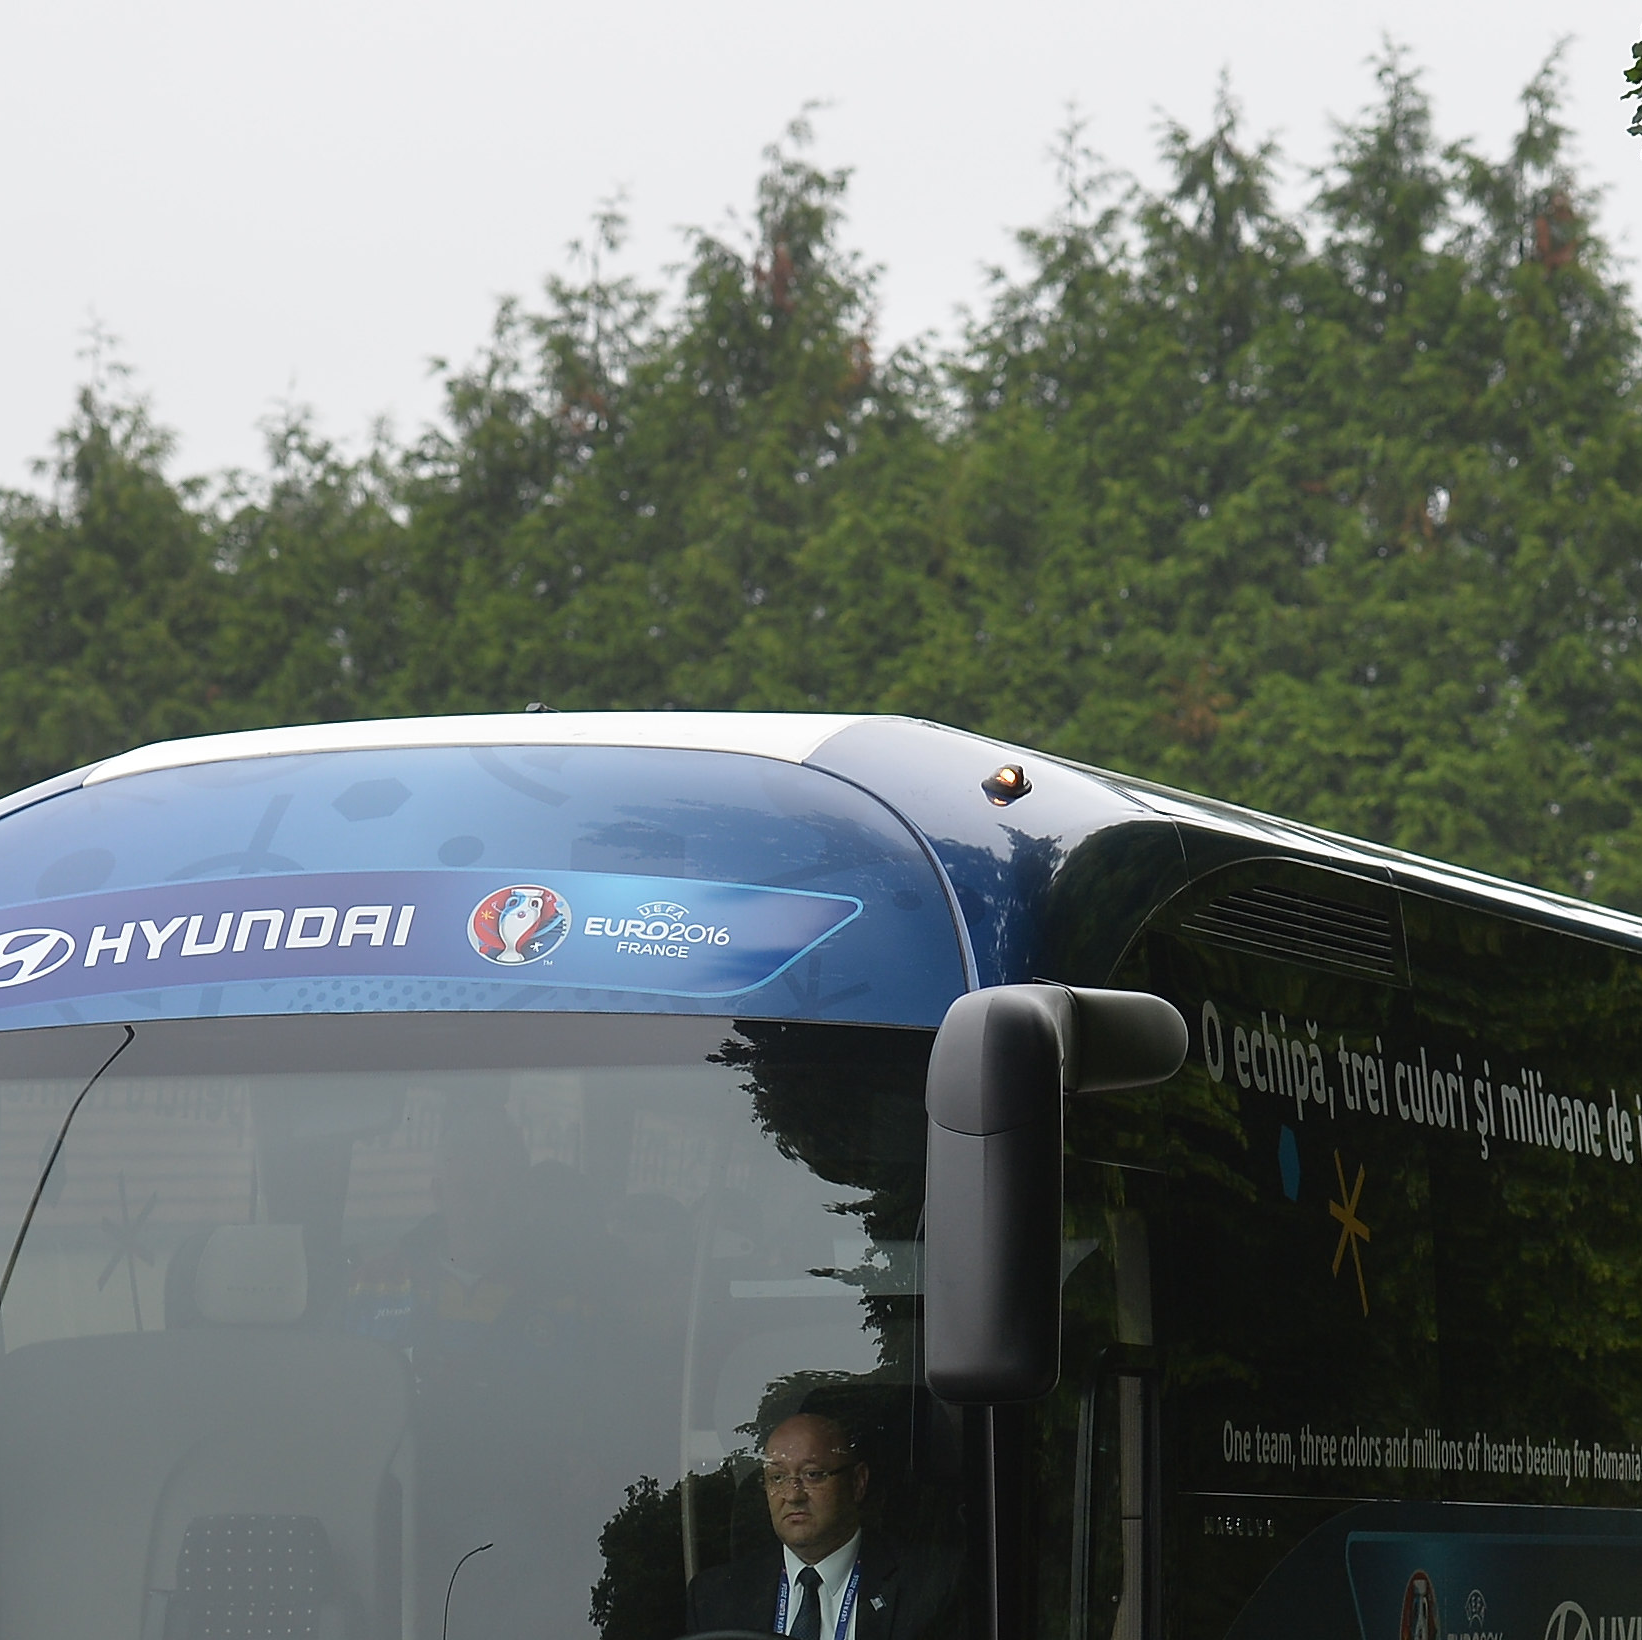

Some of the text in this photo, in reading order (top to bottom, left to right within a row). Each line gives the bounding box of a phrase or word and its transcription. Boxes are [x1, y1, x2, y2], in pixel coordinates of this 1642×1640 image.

[583, 917, 731, 946] EURO2016
[638, 904, 685, 921] UEFA
[83, 904, 416, 968] HYUNDAI
[616, 941, 690, 959] FRANCE
[1202, 1000, 1225, 1083] O
[1233, 1011, 1335, 1121] echipă,
[1338, 1034, 1389, 1116] trei
[1394, 1046, 1469, 1132] culori
[1500, 1067, 1603, 1158] milioane
[1607, 1089, 1634, 1165] de
[1222, 1420, 1252, 1463] One
[1255, 1424, 1297, 1472] team,
[1299, 1424, 1337, 1466] three
[1340, 1426, 1382, 1468] colors
[1384, 1428, 1409, 1468] and
[1412, 1428, 1464, 1471] millions
[1466, 1431, 1481, 1471] of
[1483, 1432, 1524, 1475] hearts
[1526, 1435, 1571, 1488] beating
[1572, 1439, 1591, 1478] for
